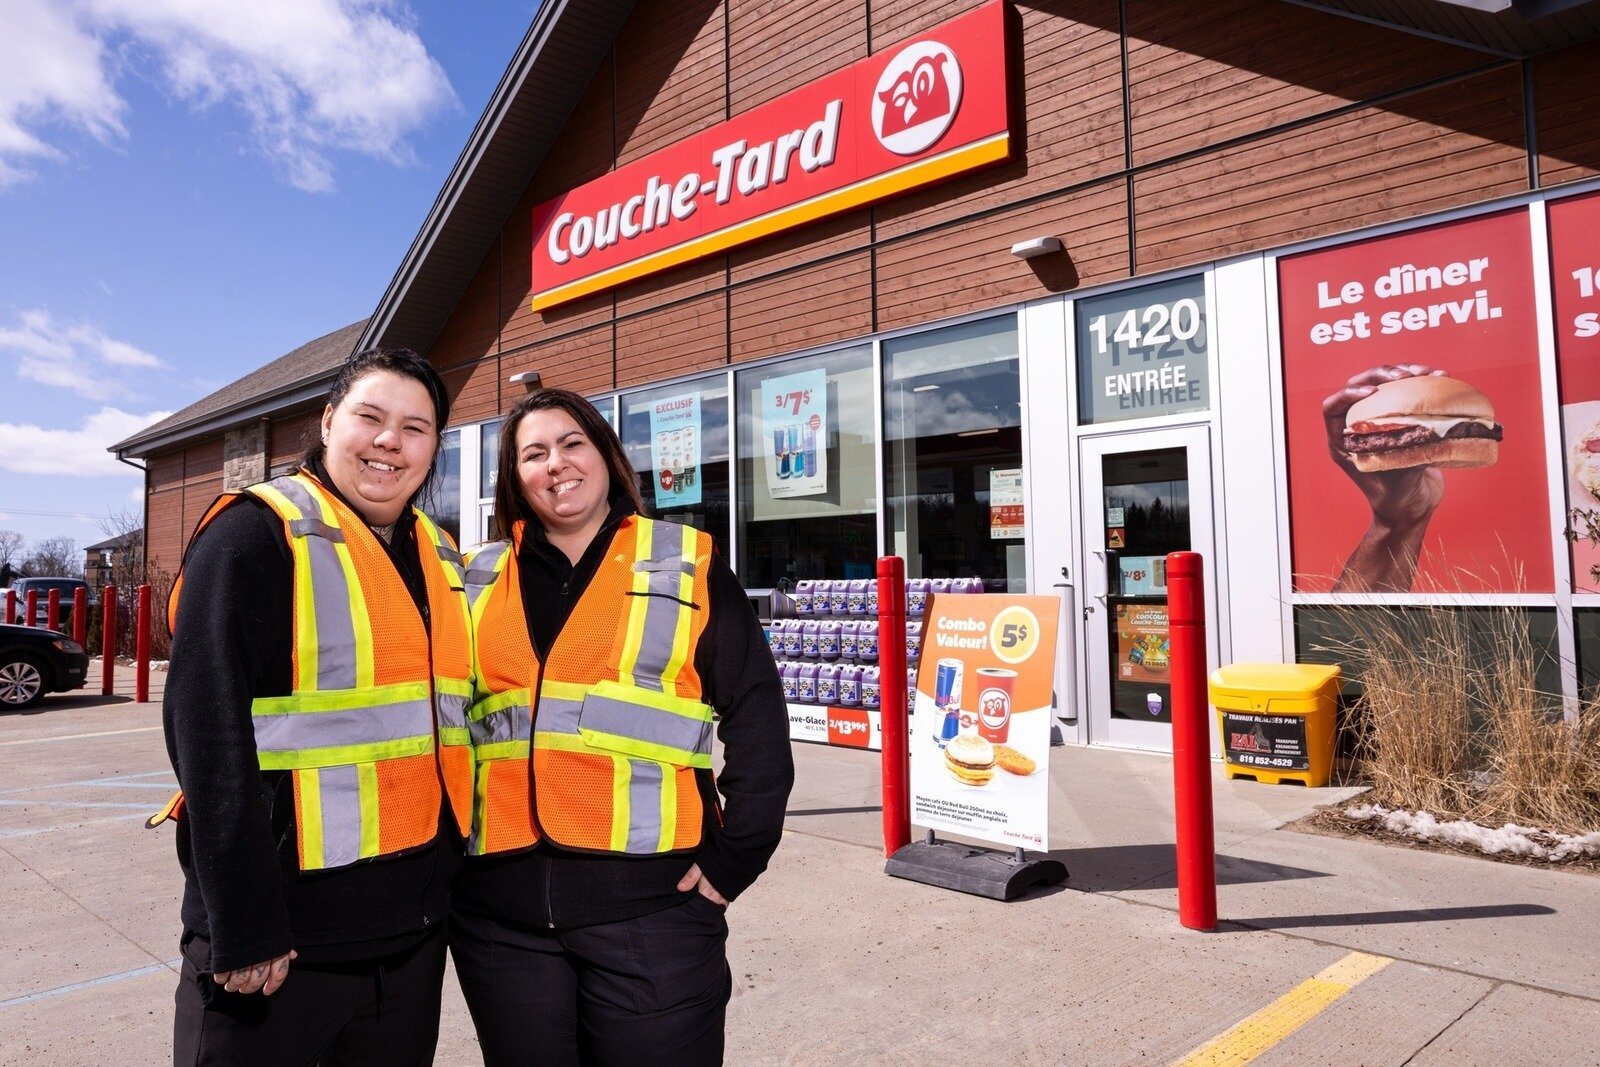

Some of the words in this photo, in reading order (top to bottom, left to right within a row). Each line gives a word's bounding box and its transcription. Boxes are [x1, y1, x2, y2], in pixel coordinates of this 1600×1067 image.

[547, 99, 842, 264] Couche-Tard
[1318, 281, 1364, 309] Le
[1374, 257, 1489, 298] dîner
[1571, 266, 1600, 297] 1
[1089, 298, 1200, 354] 1420
[1310, 312, 1371, 345] est
[1380, 289, 1502, 335] servi.
[1105, 362, 1187, 397] ENTRÉE
[656, 398, 693, 414] EXCLUSIF
[938, 616, 986, 632] Combo
[1001, 624, 1027, 648] 5$
[936, 633, 987, 650] Valeur!
[790, 714, 826, 726] ave-Glace
[1229, 713, 1253, 722] TRAVAUX
[1284, 717, 1297, 725] PAR
[1240, 755, 1254, 763] 819
[1255, 756, 1293, 767] 852-4529
